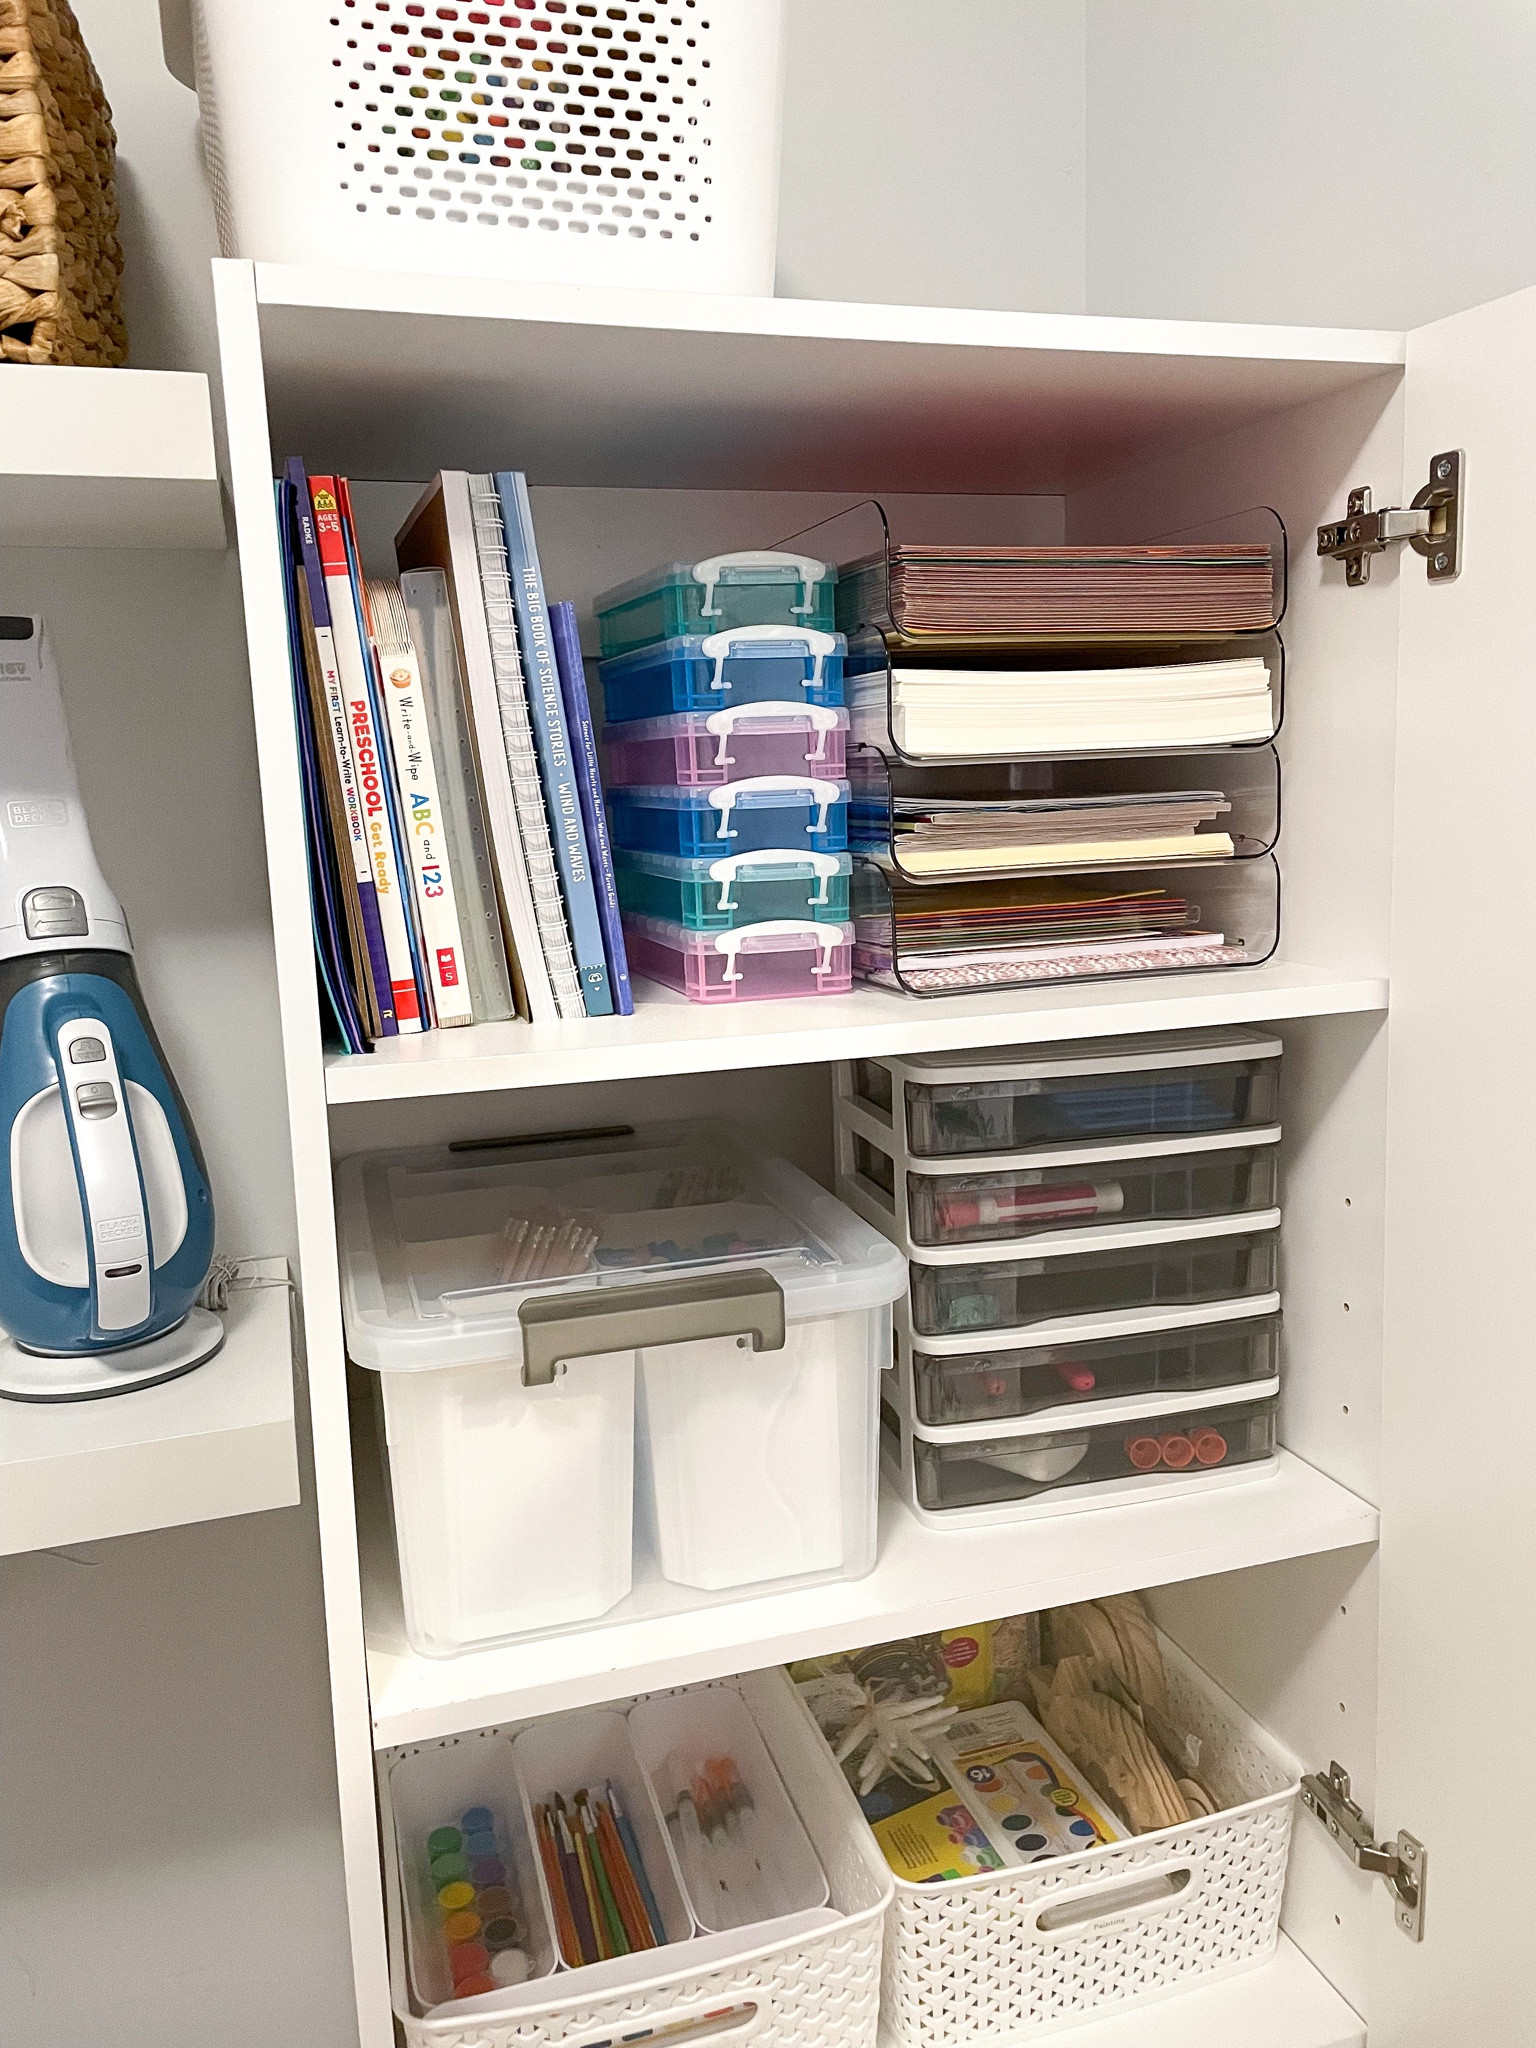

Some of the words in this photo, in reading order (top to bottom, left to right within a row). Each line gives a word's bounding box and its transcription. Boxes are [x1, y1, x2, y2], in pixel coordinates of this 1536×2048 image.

[318, 513, 338, 521] AGES
[319, 521, 340, 533] 3-5
[302, 516, 313, 545] RADKE
[523, 566, 538, 589] THE
[527, 592, 542, 613] BIG
[530, 616, 548, 648] BOOK
[536, 651, 550, 665] OF
[326, 670, 336, 685] MY
[329, 686, 342, 713] FIRST
[539, 668, 560, 717] SCIENCE
[398, 696, 423, 781] Write-and-Wipe
[582, 720, 590, 741] Science
[335, 716, 352, 785] Learn-to-Write
[547, 719, 567, 768] STORIES
[350, 700, 383, 817] PRESCHOOL
[587, 752, 595, 767] Little
[589, 768, 597, 787] Hearts
[558, 782, 575, 815] WIND
[592, 788, 600, 798] and
[346, 787, 363, 842] WORKBOOK
[409, 793, 435, 836] ABC
[594, 799, 603, 817] Hands
[370, 822, 382, 848] Get
[564, 818, 579, 841] AND
[423, 839, 436, 860] and
[599, 838, 607, 850] and
[568, 843, 586, 883] WAVES
[601, 850, 610, 868] Waves
[375, 851, 391, 894] Ready
[421, 865, 445, 898] 123
[605, 873, 613, 892] Parent
[608, 892, 616, 909] Guide
[445, 972, 454, 981] S
[969, 1767, 991, 1782] 16
